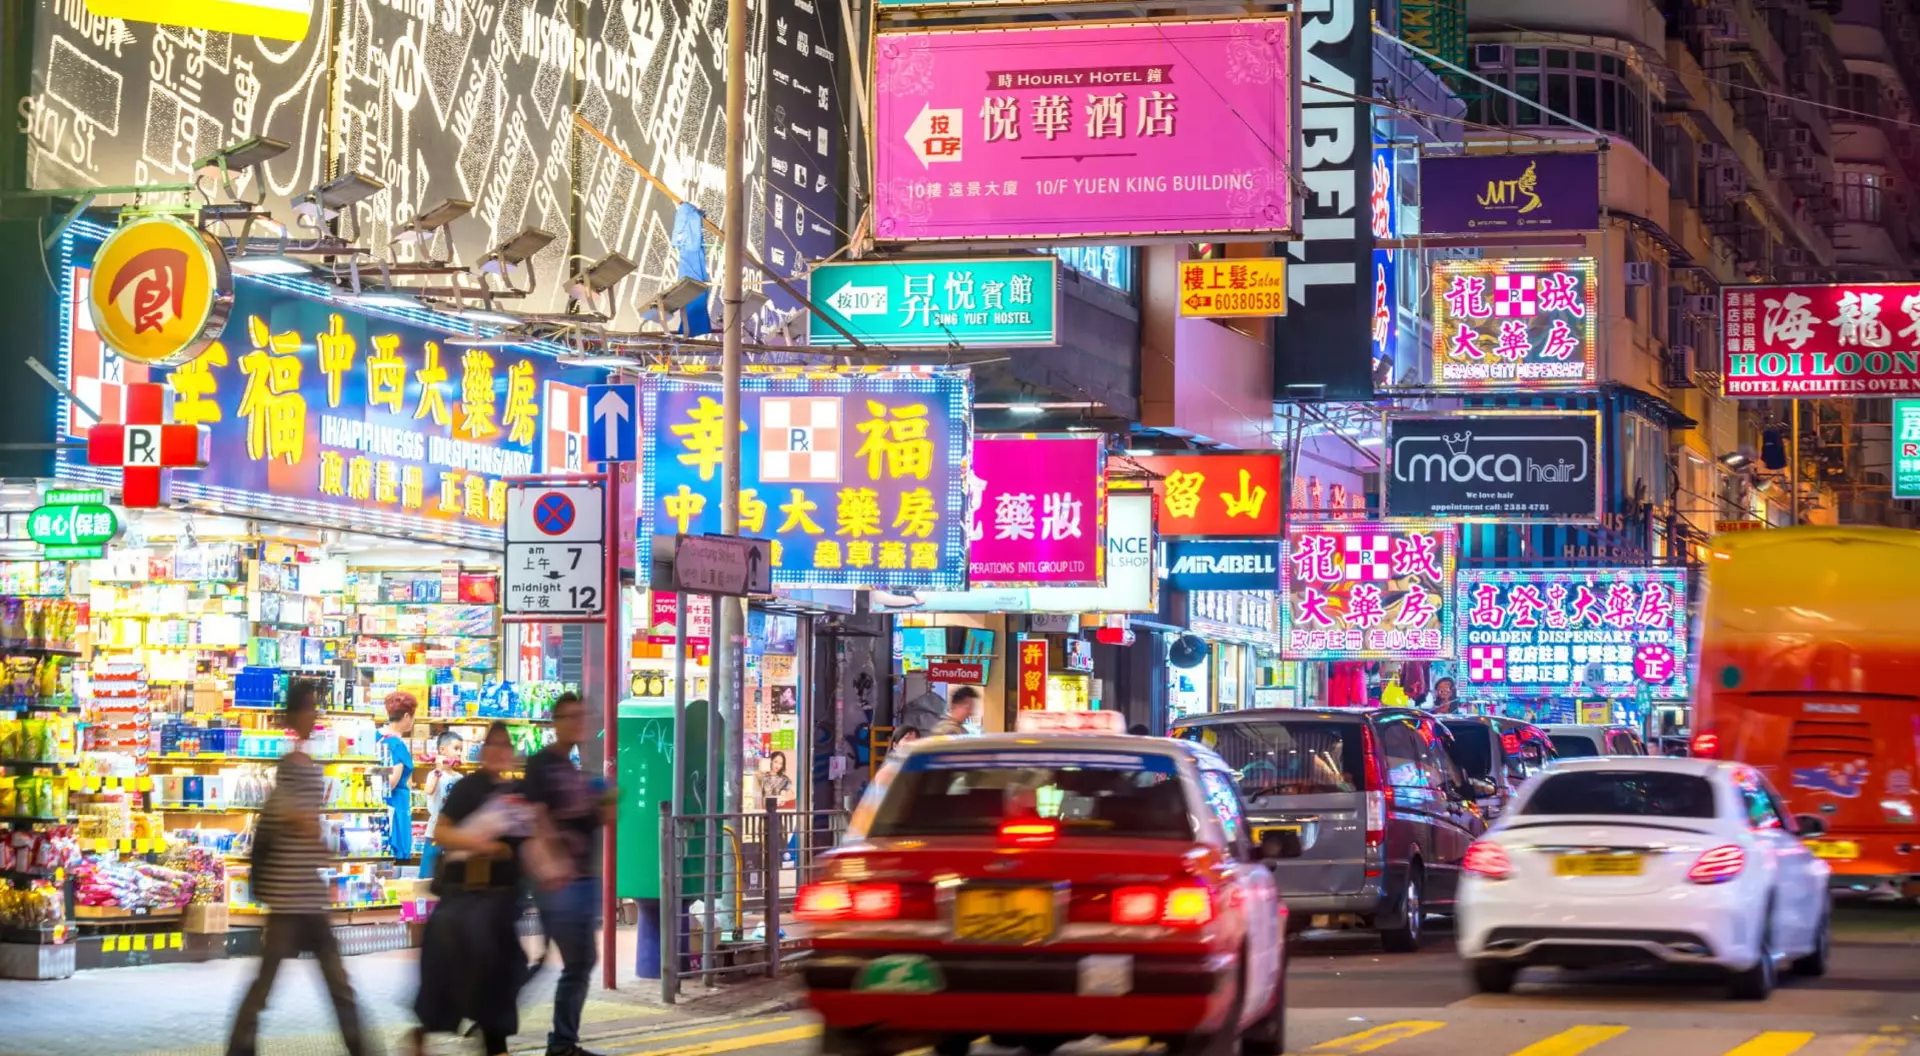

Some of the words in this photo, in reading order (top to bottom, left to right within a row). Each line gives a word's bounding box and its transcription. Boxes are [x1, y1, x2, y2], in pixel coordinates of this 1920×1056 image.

[1090, 70, 1142, 84] HOTEL
[1035, 180, 1069, 197] 10/F
[1073, 178, 1120, 195] YUEN
[1126, 176, 1167, 193] KING
[1173, 174, 1254, 192] BUILDING
[1184, 265, 1249, 291] 樓上髮
[1249, 272, 1281, 288] Salon
[836, 292, 887, 309] 按10字
[1214, 292, 1281, 311] 60380538
[1444, 274, 1492, 318] 龍
[1538, 273, 1585, 317] 城
[963, 312, 988, 324] YUET
[993, 312, 1032, 324] HOSTEL
[1450, 320, 1579, 360] 大藥房
[1728, 353, 1804, 376] HOI
[1729, 381, 1780, 392] HOTEL
[1868, 379, 1909, 391] OVER
[854, 399, 935, 481] 福
[1408, 453, 1522, 483] moca
[1526, 460, 1575, 483] hair
[1164, 467, 1268, 519] 留山
[1465, 491, 1477, 499] We
[1478, 491, 1495, 499] love
[1497, 491, 1515, 499] hair
[523, 558, 551, 571] 上午
[528, 546, 545, 555] am
[567, 548, 583, 570] 7
[1038, 561, 1068, 573] GROUP
[1069, 561, 1085, 572] LTD
[1291, 536, 1341, 581] 龍
[1392, 533, 1441, 580] 城
[512, 583, 561, 595] midnight
[568, 587, 597, 609] 12
[523, 596, 550, 608] 午夜
[1297, 584, 1437, 627] 大藥房
[1470, 631, 1532, 643] GOLDEN
[1538, 630, 1632, 643] DISPENSARY
[931, 665, 979, 679] SmarTone
